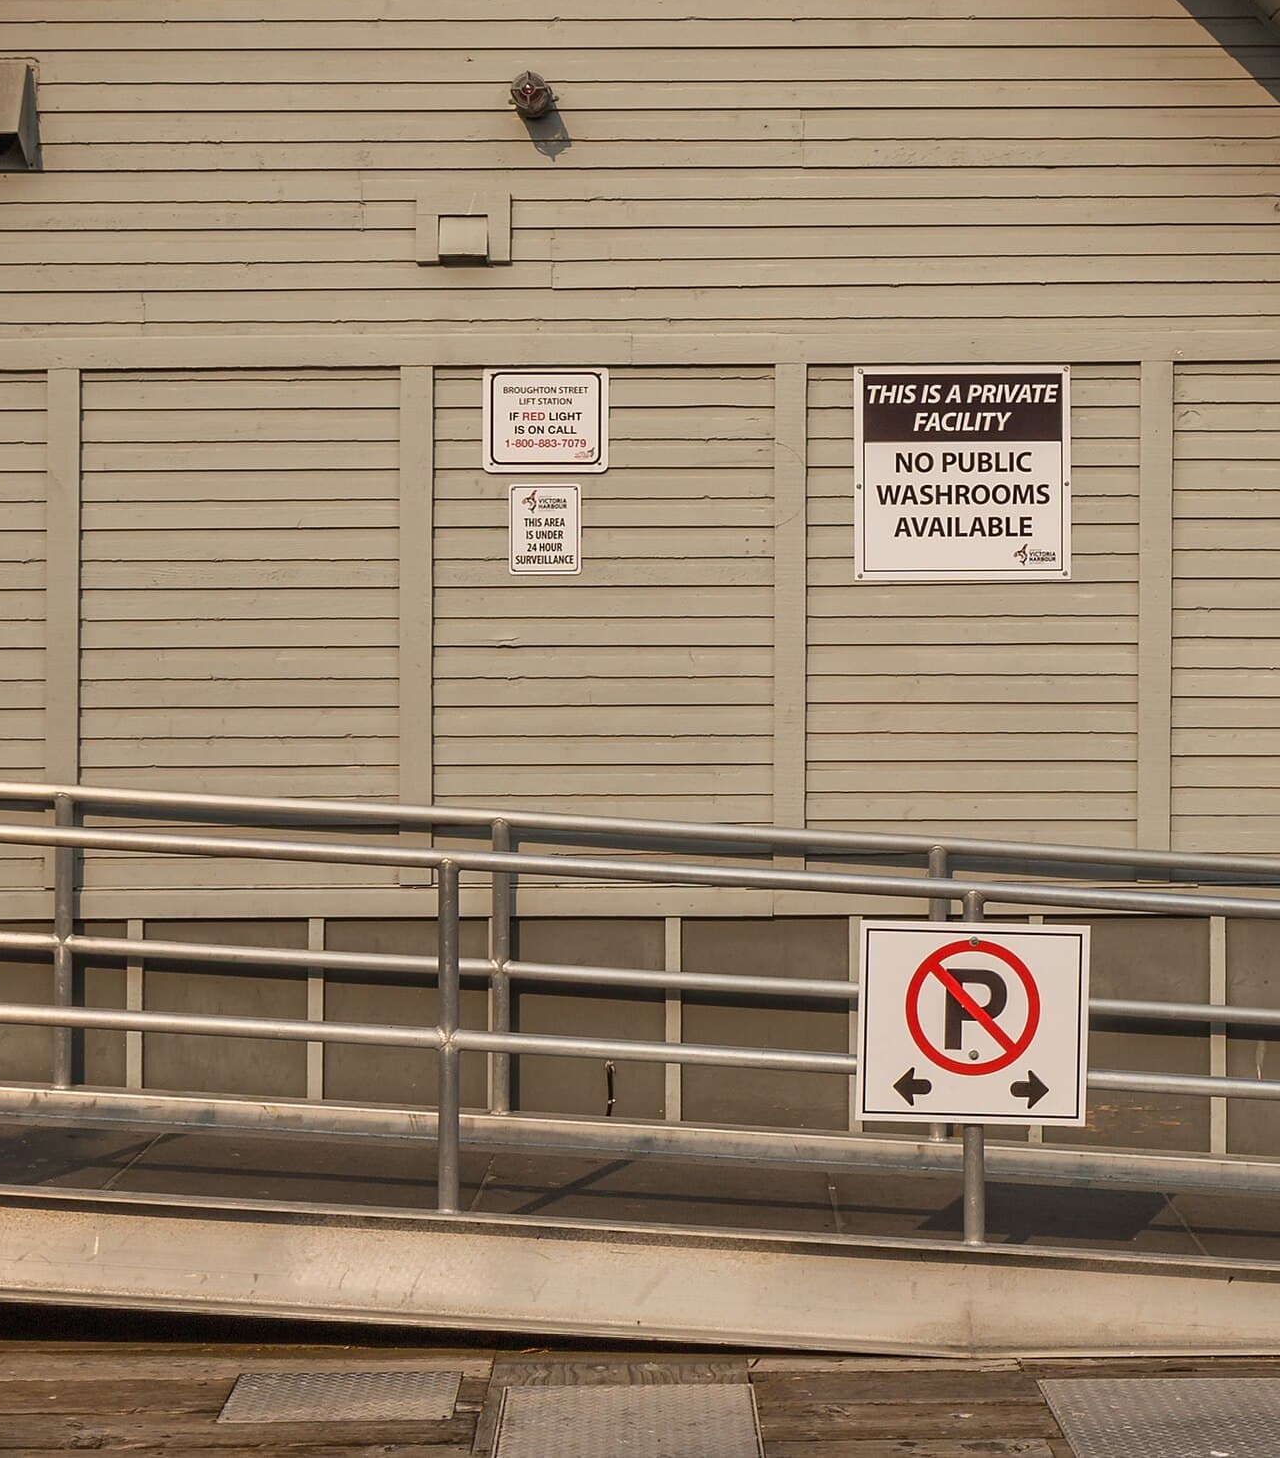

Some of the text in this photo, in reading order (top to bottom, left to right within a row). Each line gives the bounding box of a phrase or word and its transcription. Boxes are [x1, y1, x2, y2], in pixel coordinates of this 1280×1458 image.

[867, 384, 1058, 404] THIS IS A PRIVATE
[510, 412, 582, 421] IF RED LIGHT
[913, 412, 1012, 431] FACILITY
[515, 426, 576, 434] IS ON CALL
[895, 452, 1032, 473] NO PUBLIC
[876, 484, 1050, 505] WASHROOMS
[524, 518, 565, 526] THIS AREA
[894, 517, 1033, 537] AVAILABLE
[526, 530, 563, 539] IS UNDER
[527, 543, 562, 551] 24 HOUR
[515, 555, 574, 564] SURVEILLANCE
[945, 969, 1008, 1050] P
